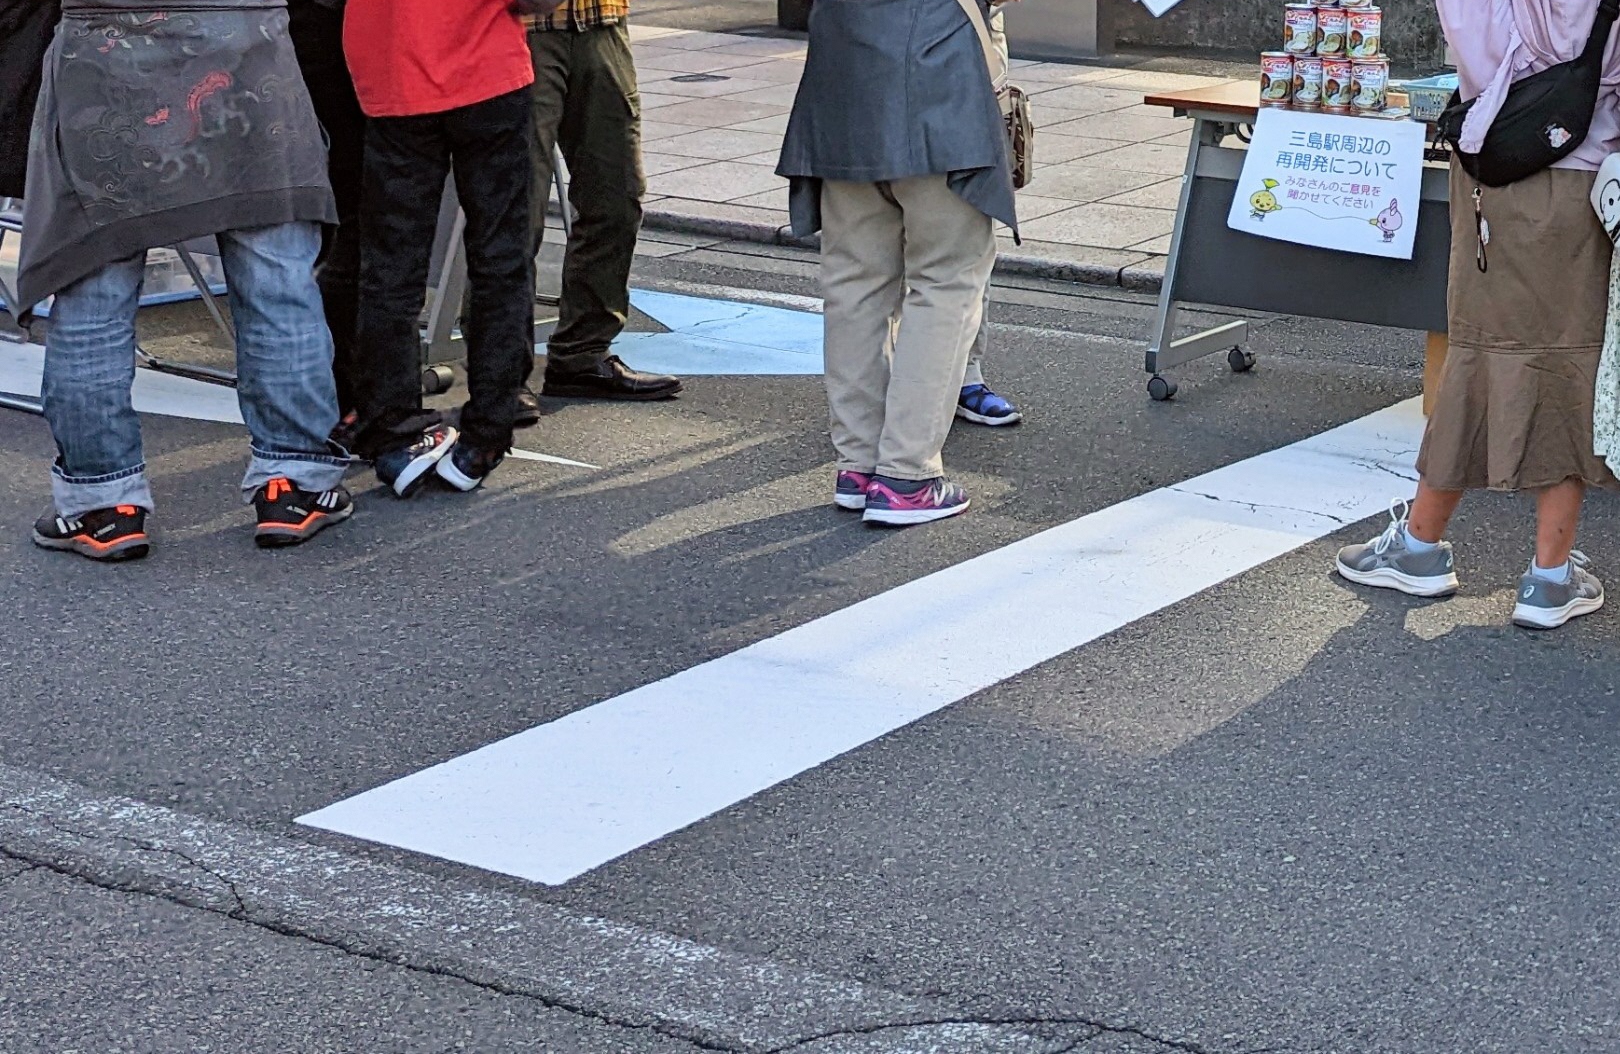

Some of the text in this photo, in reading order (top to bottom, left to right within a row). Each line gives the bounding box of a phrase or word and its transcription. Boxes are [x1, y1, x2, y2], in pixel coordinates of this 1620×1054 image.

[1288, 130, 1391, 156] 三島駅周辺の
[1276, 150, 1398, 180] 再開発について
[1284, 175, 1382, 197] みなさんのご意見を
[1286, 188, 1374, 209] 聞かせてください
